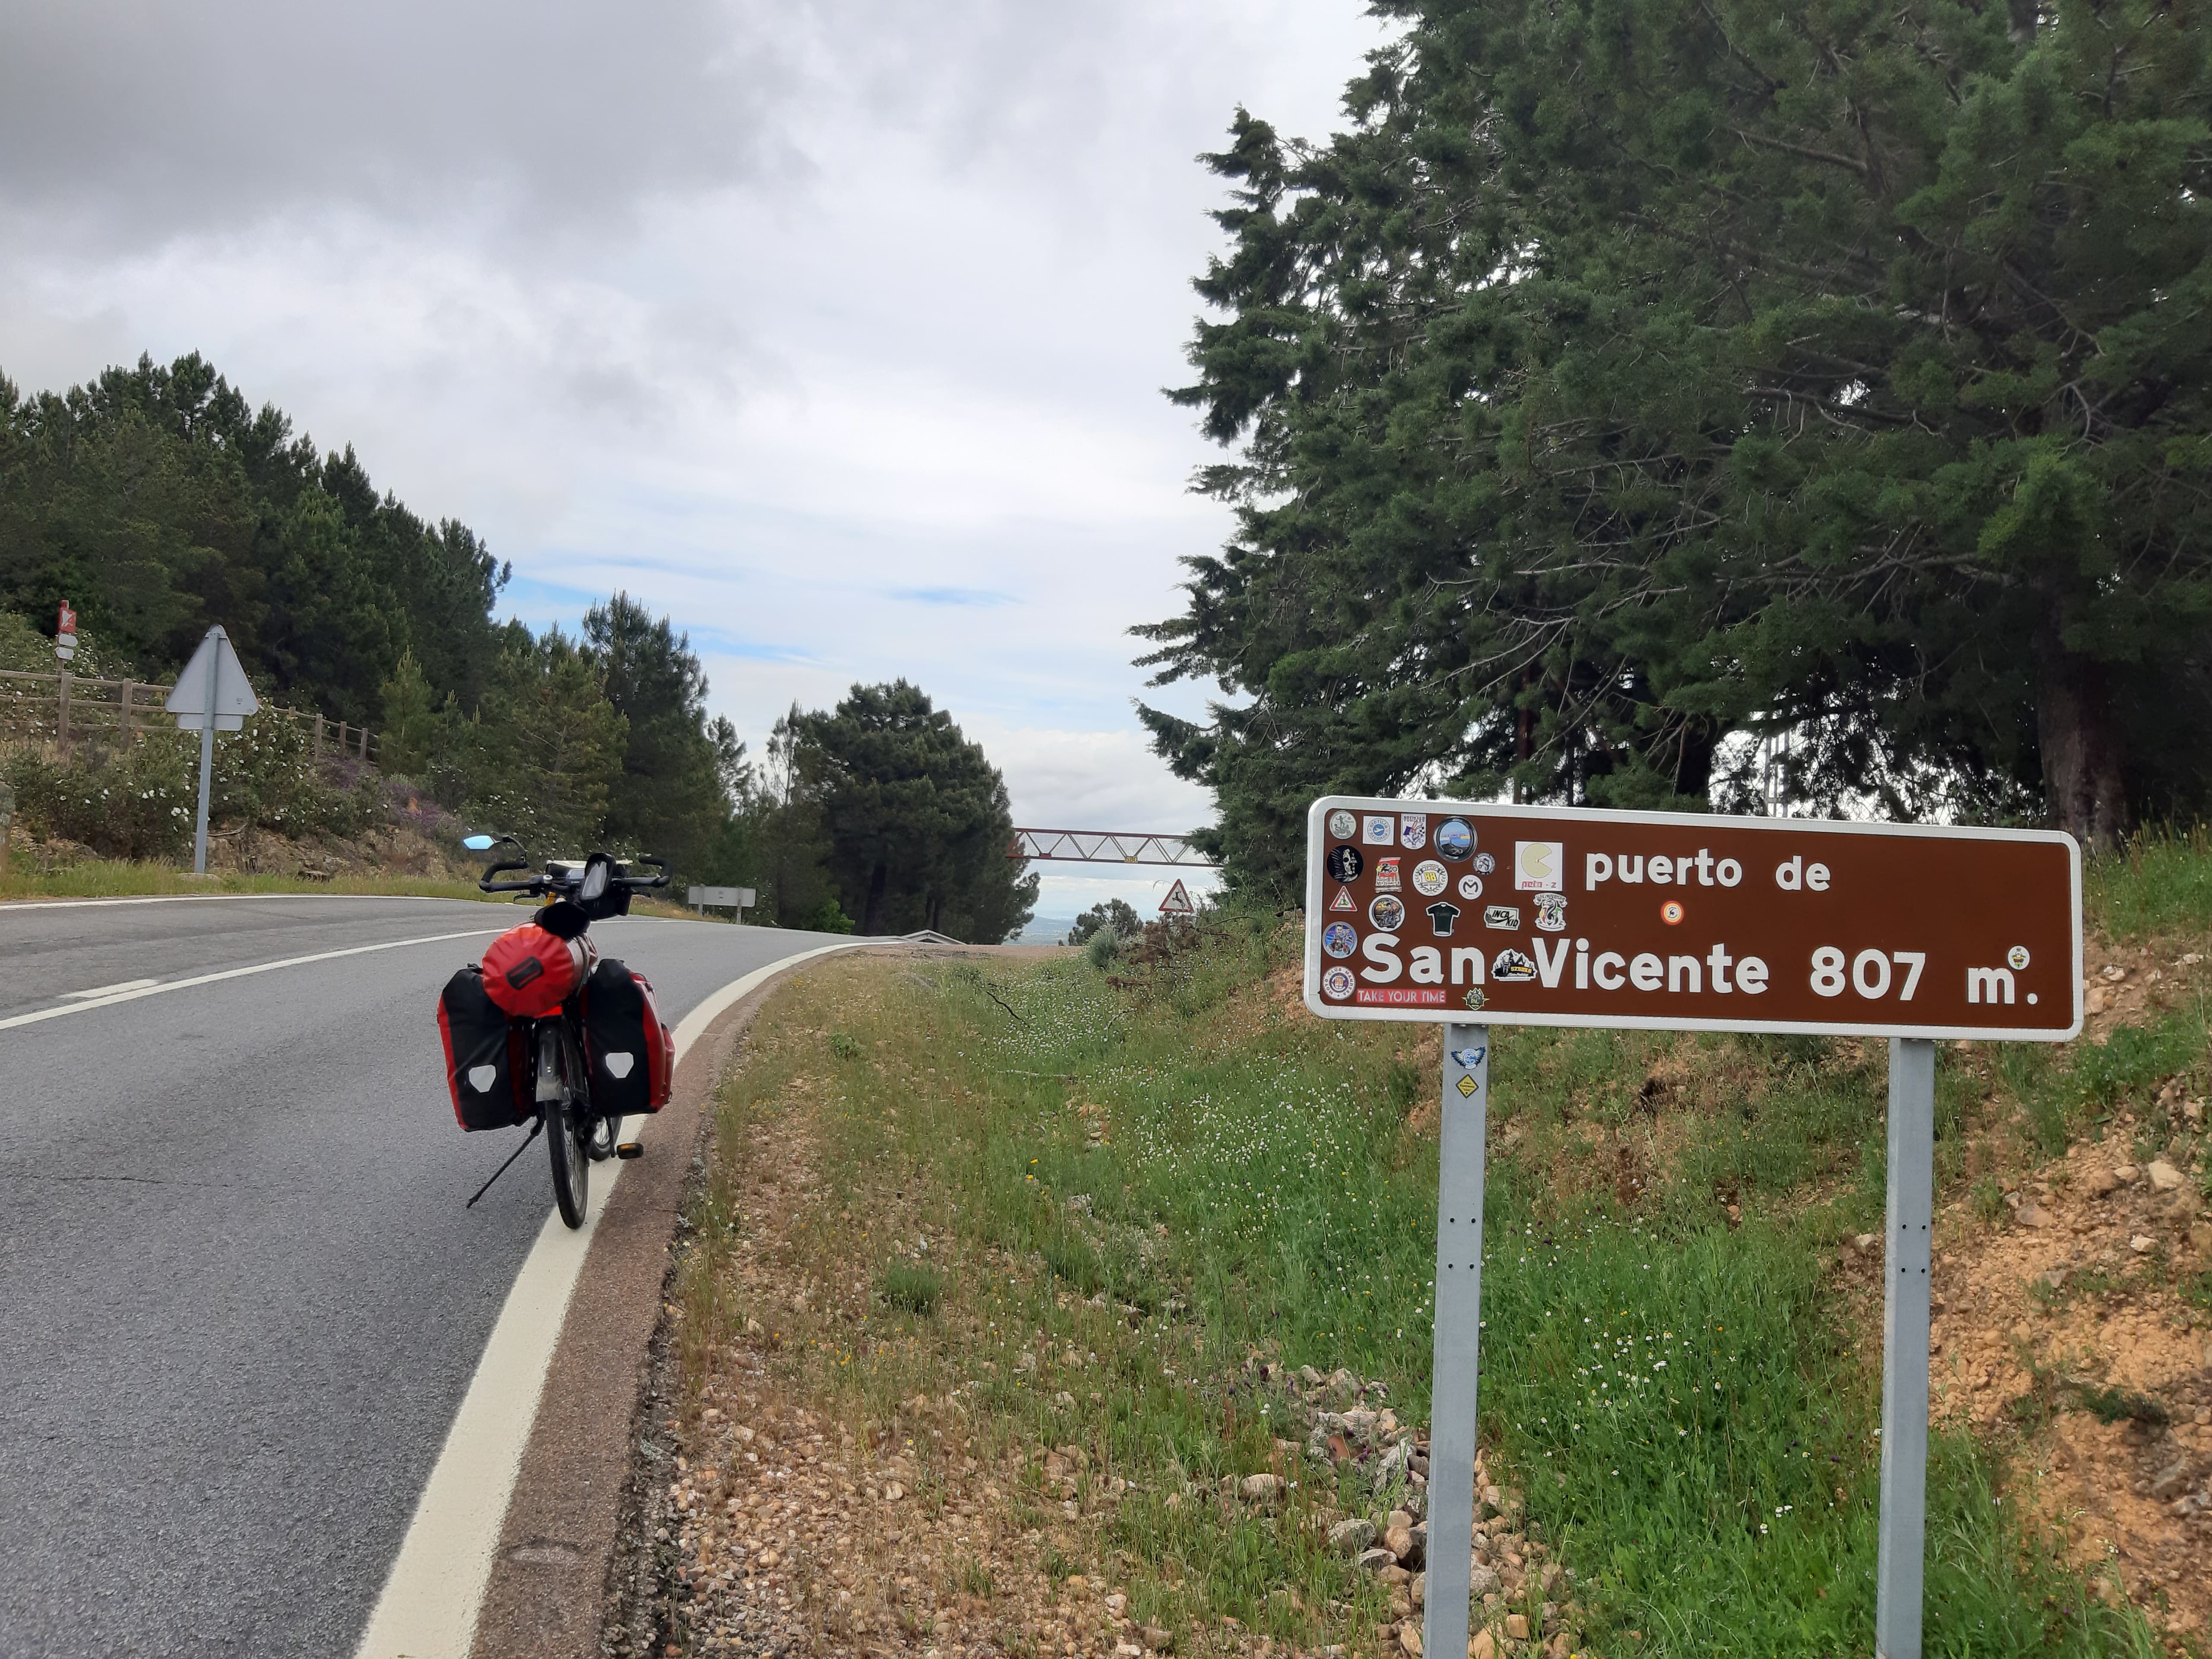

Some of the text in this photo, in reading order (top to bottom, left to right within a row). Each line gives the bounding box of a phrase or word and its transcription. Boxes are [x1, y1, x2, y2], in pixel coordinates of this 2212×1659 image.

[1586, 848, 1831, 891] puerto de
[1492, 910, 1510, 918] INCA
[1360, 933, 1485, 984] San
[1532, 937, 1769, 994] Vicente
[1810, 946, 1926, 1001] 807
[1358, 990, 1446, 1003] TAKE YOUR TIME
